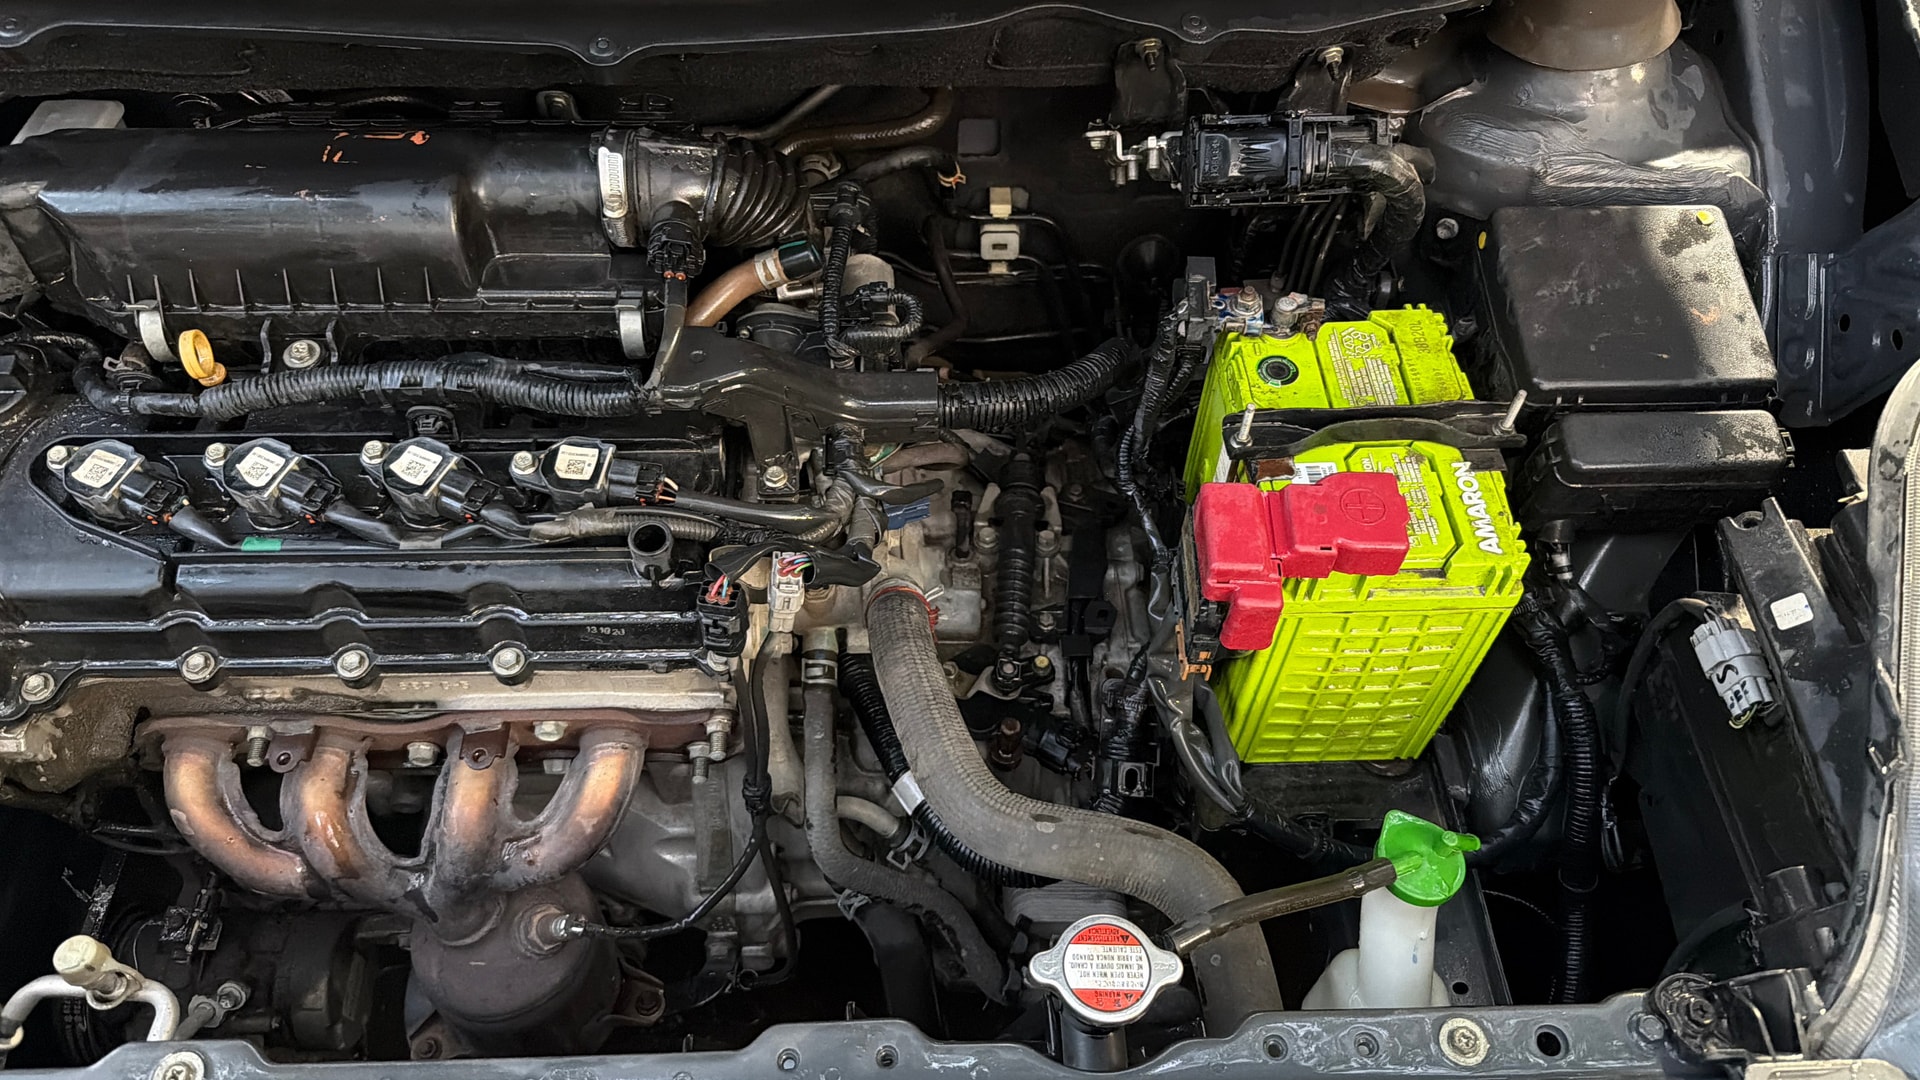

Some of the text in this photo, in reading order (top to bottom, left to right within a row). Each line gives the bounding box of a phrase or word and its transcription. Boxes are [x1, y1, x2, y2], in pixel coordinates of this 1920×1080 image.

[1451, 461, 1503, 555] AMARON
[1130, 946, 1142, 954] ESTE
[1072, 953, 1094, 961] CUANDO
[1118, 954, 1133, 962] ABRIR
[1111, 971, 1125, 979] OPEN
[1128, 971, 1144, 979] NEVER
[1095, 990, 1121, 998] WARNING
